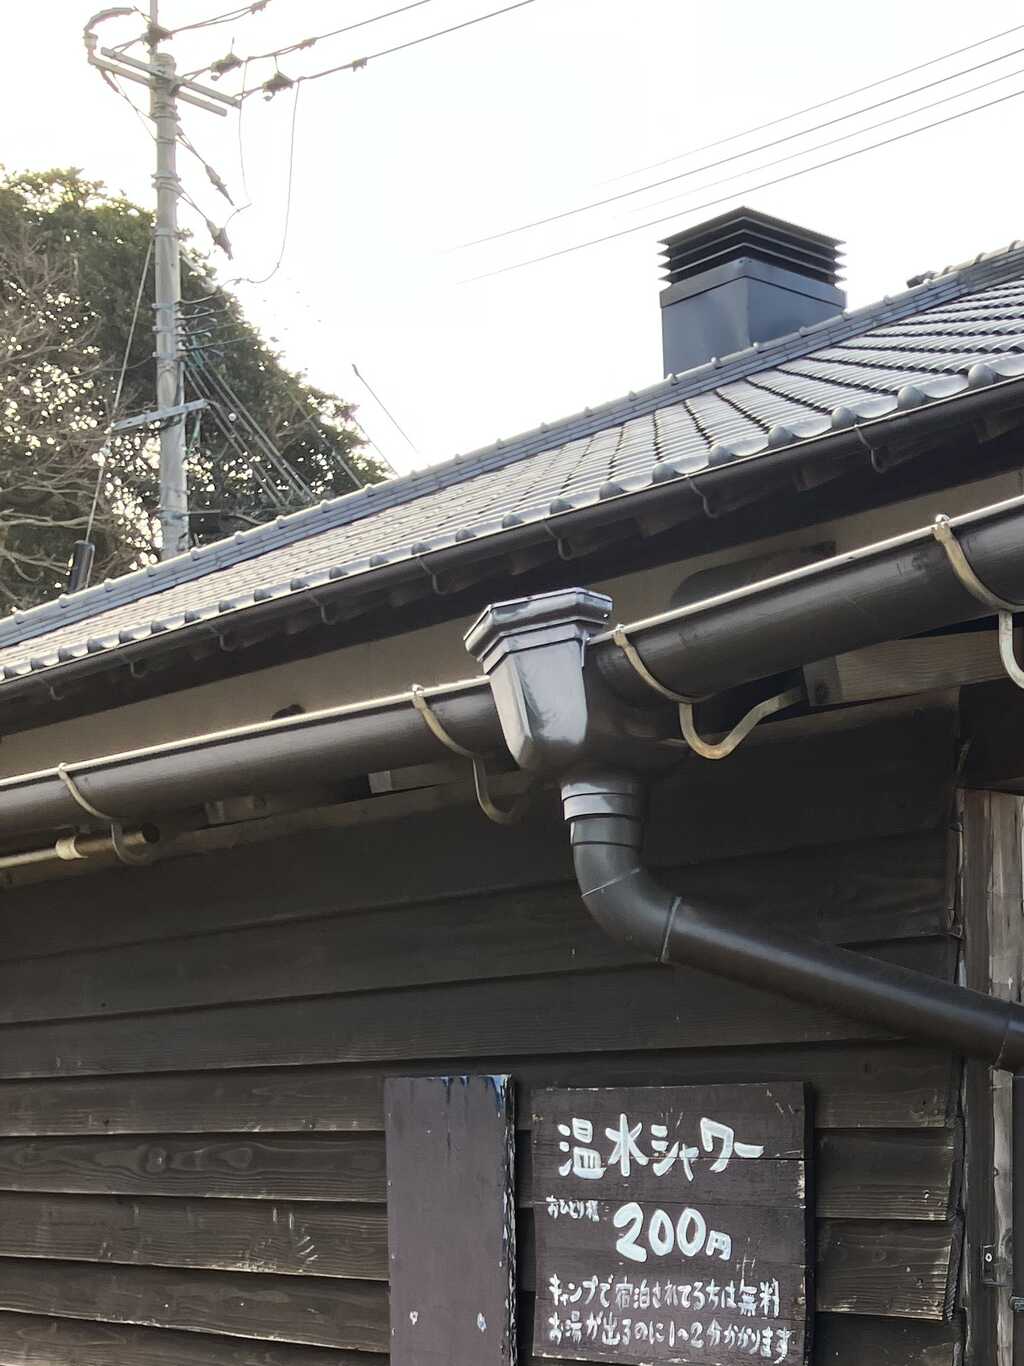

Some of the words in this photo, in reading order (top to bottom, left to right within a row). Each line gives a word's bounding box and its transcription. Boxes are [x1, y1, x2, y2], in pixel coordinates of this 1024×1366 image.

[557, 1113, 765, 1181] 温水シャワー
[613, 1201, 733, 1263] 200円
